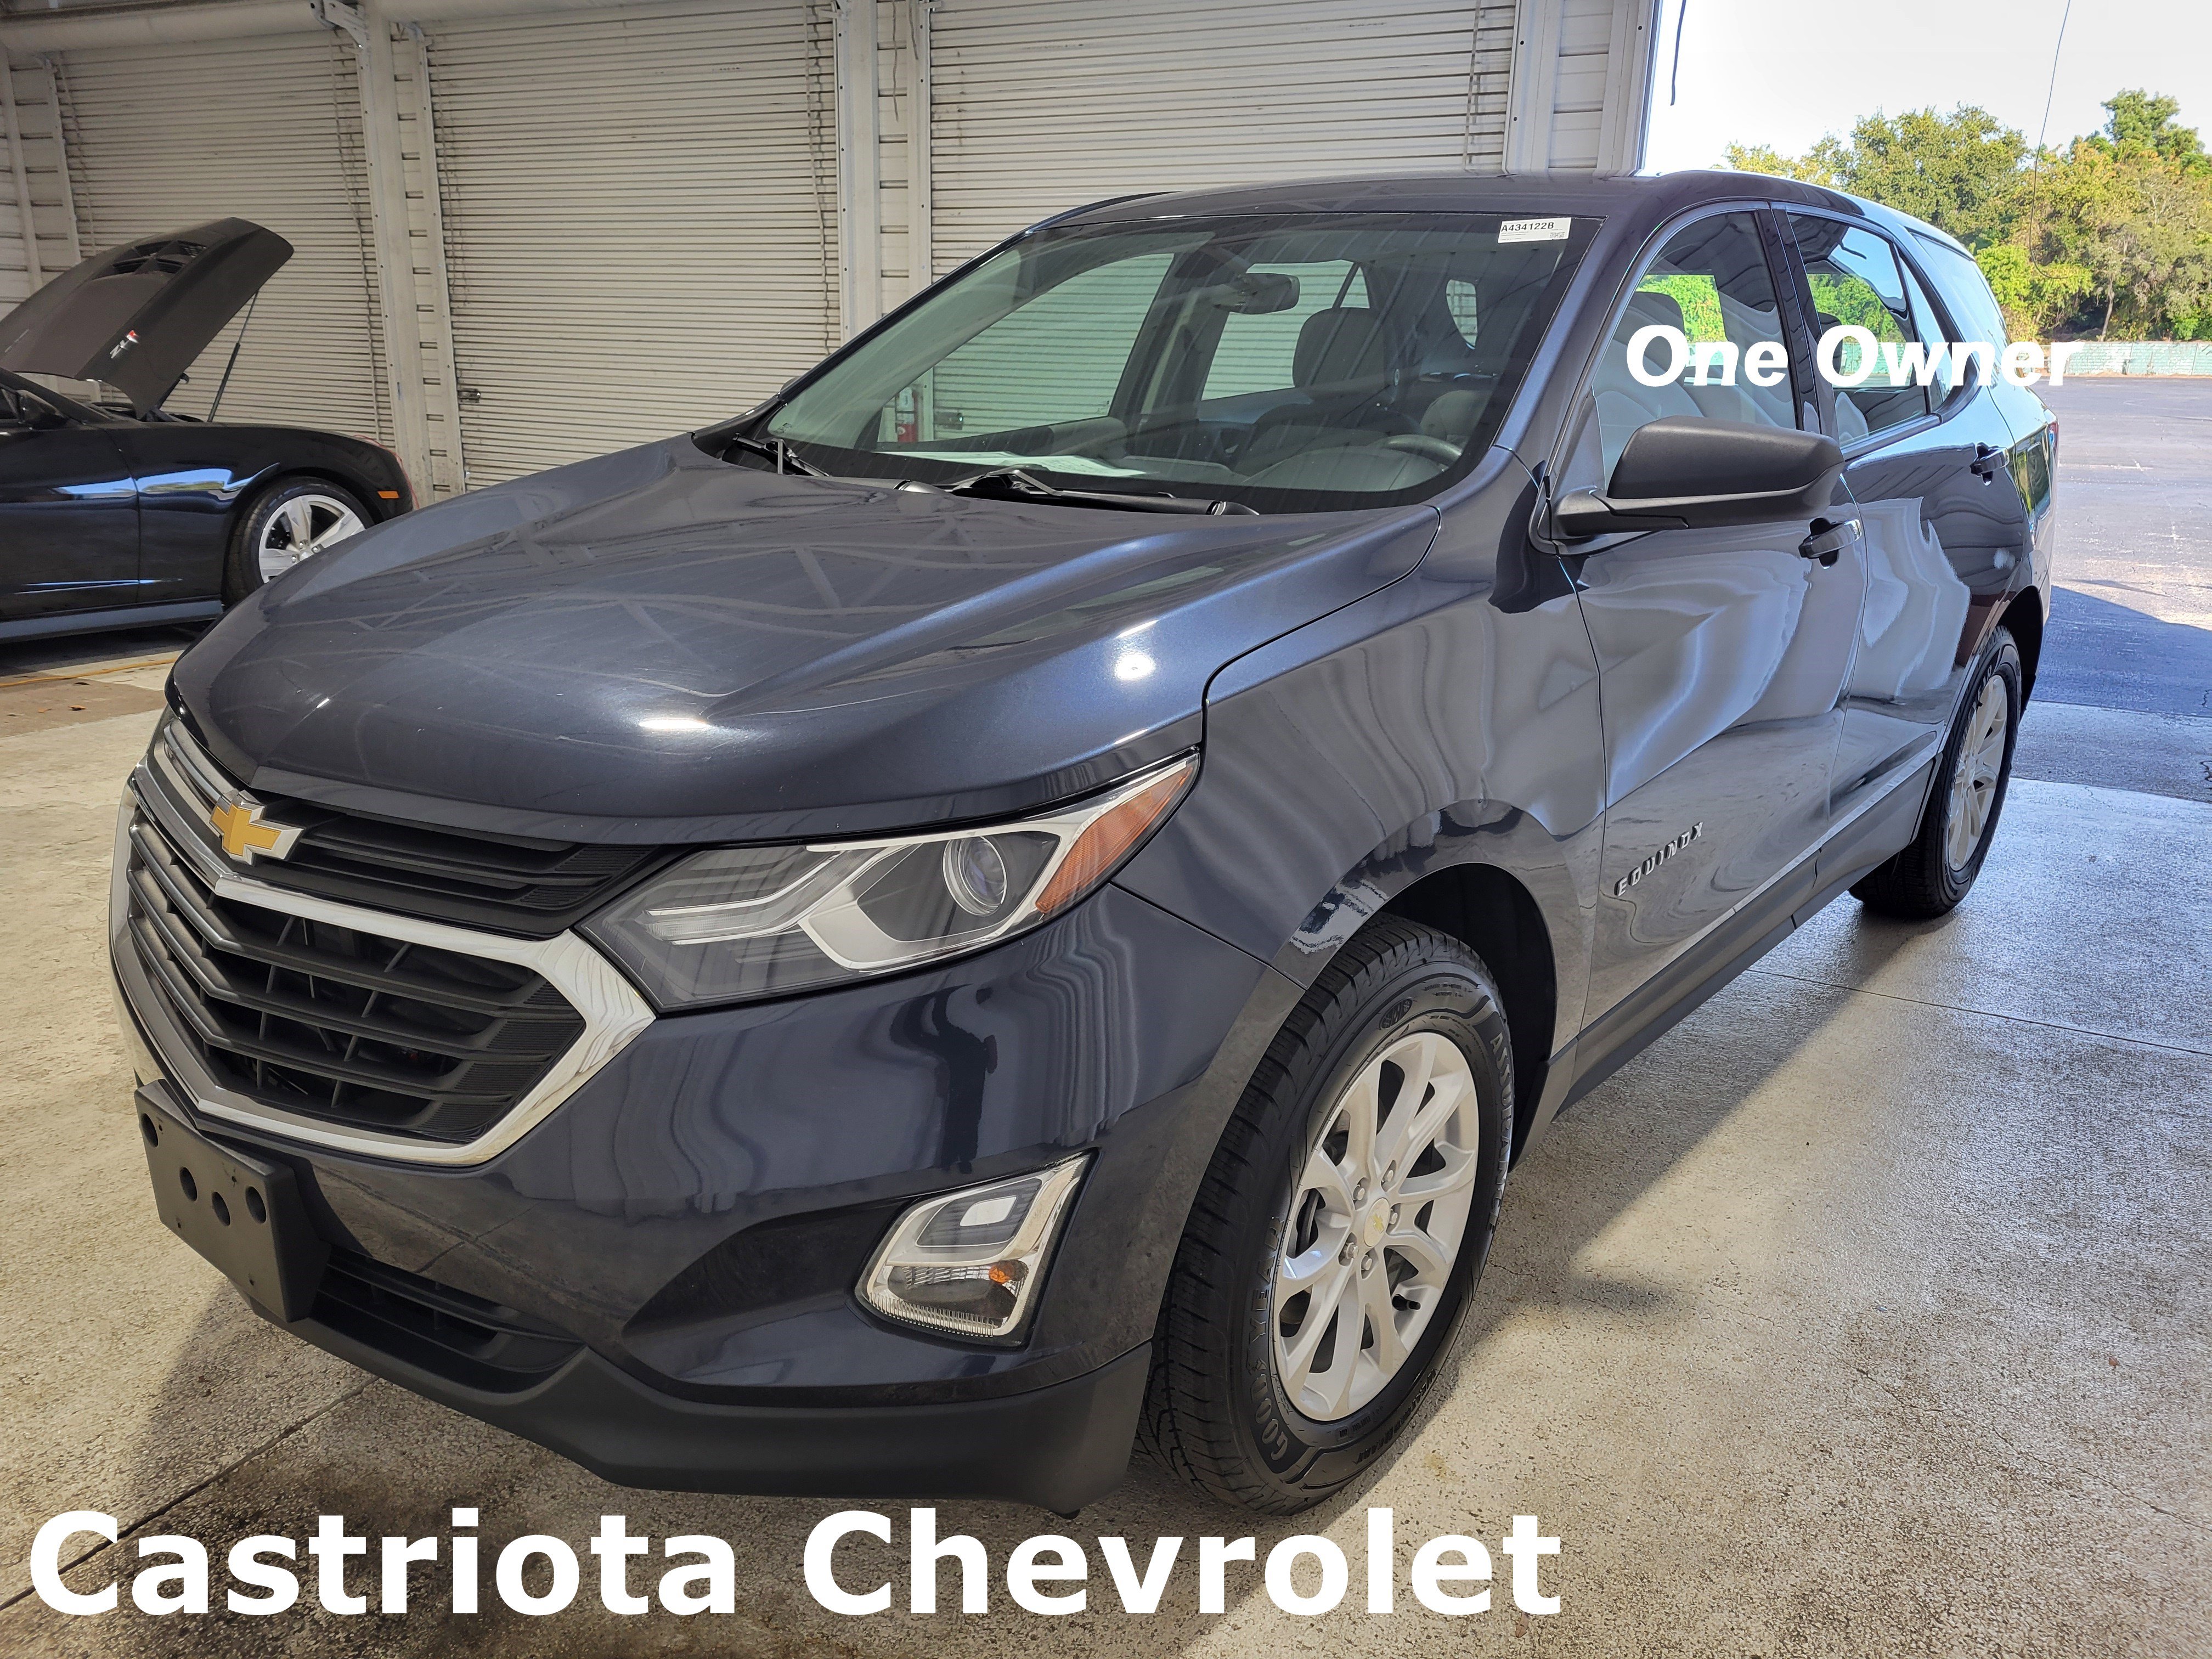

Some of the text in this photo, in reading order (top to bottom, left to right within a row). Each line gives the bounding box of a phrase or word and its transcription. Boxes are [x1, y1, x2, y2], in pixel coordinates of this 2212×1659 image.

[1501, 222, 1554, 232] A434122B
[1613, 821, 1703, 896] EQUINOX
[1487, 1031, 1513, 1234] ASSURANCE
[1249, 1215, 1288, 1461] GOODYEAR
